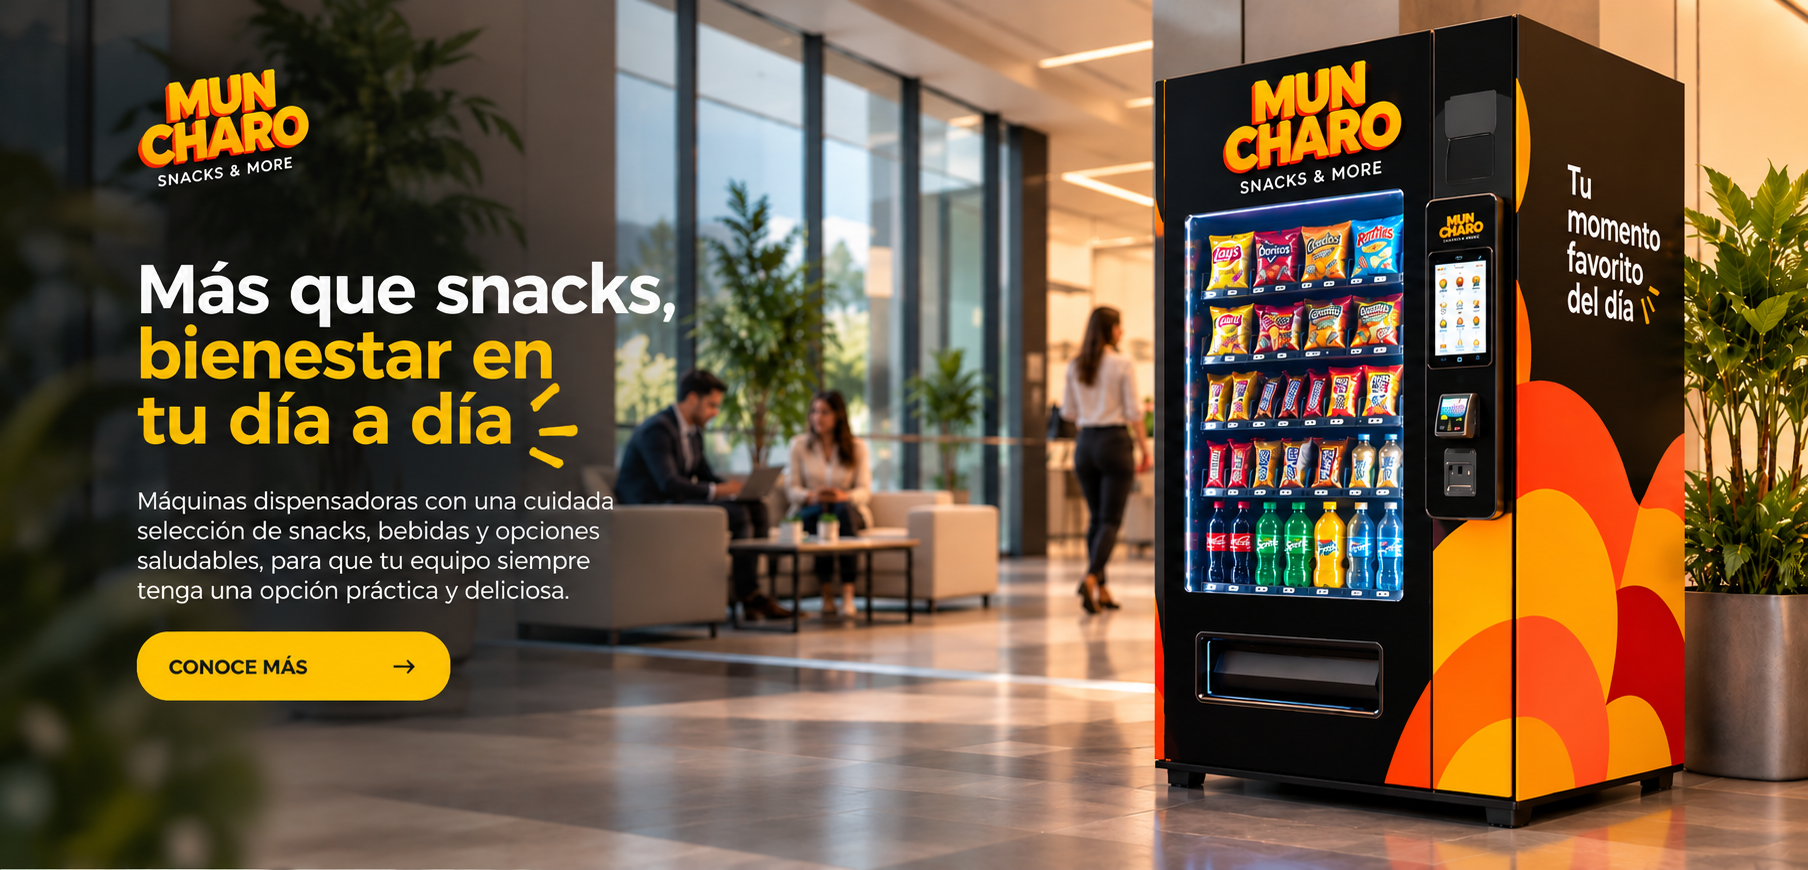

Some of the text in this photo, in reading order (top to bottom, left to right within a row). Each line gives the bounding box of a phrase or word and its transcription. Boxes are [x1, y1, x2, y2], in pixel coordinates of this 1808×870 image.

[1251, 60, 1366, 125] MUN
[1223, 101, 1402, 174] CHARO
[1240, 160, 1382, 194] SNACKS & MORE
[1567, 164, 1592, 200] Tu
[1439, 221, 1484, 239] CHARO
[1446, 212, 1475, 230] MUN
[1567, 209, 1661, 252] momento
[1567, 241, 1644, 286] favorito
[1567, 282, 1634, 322] del día
